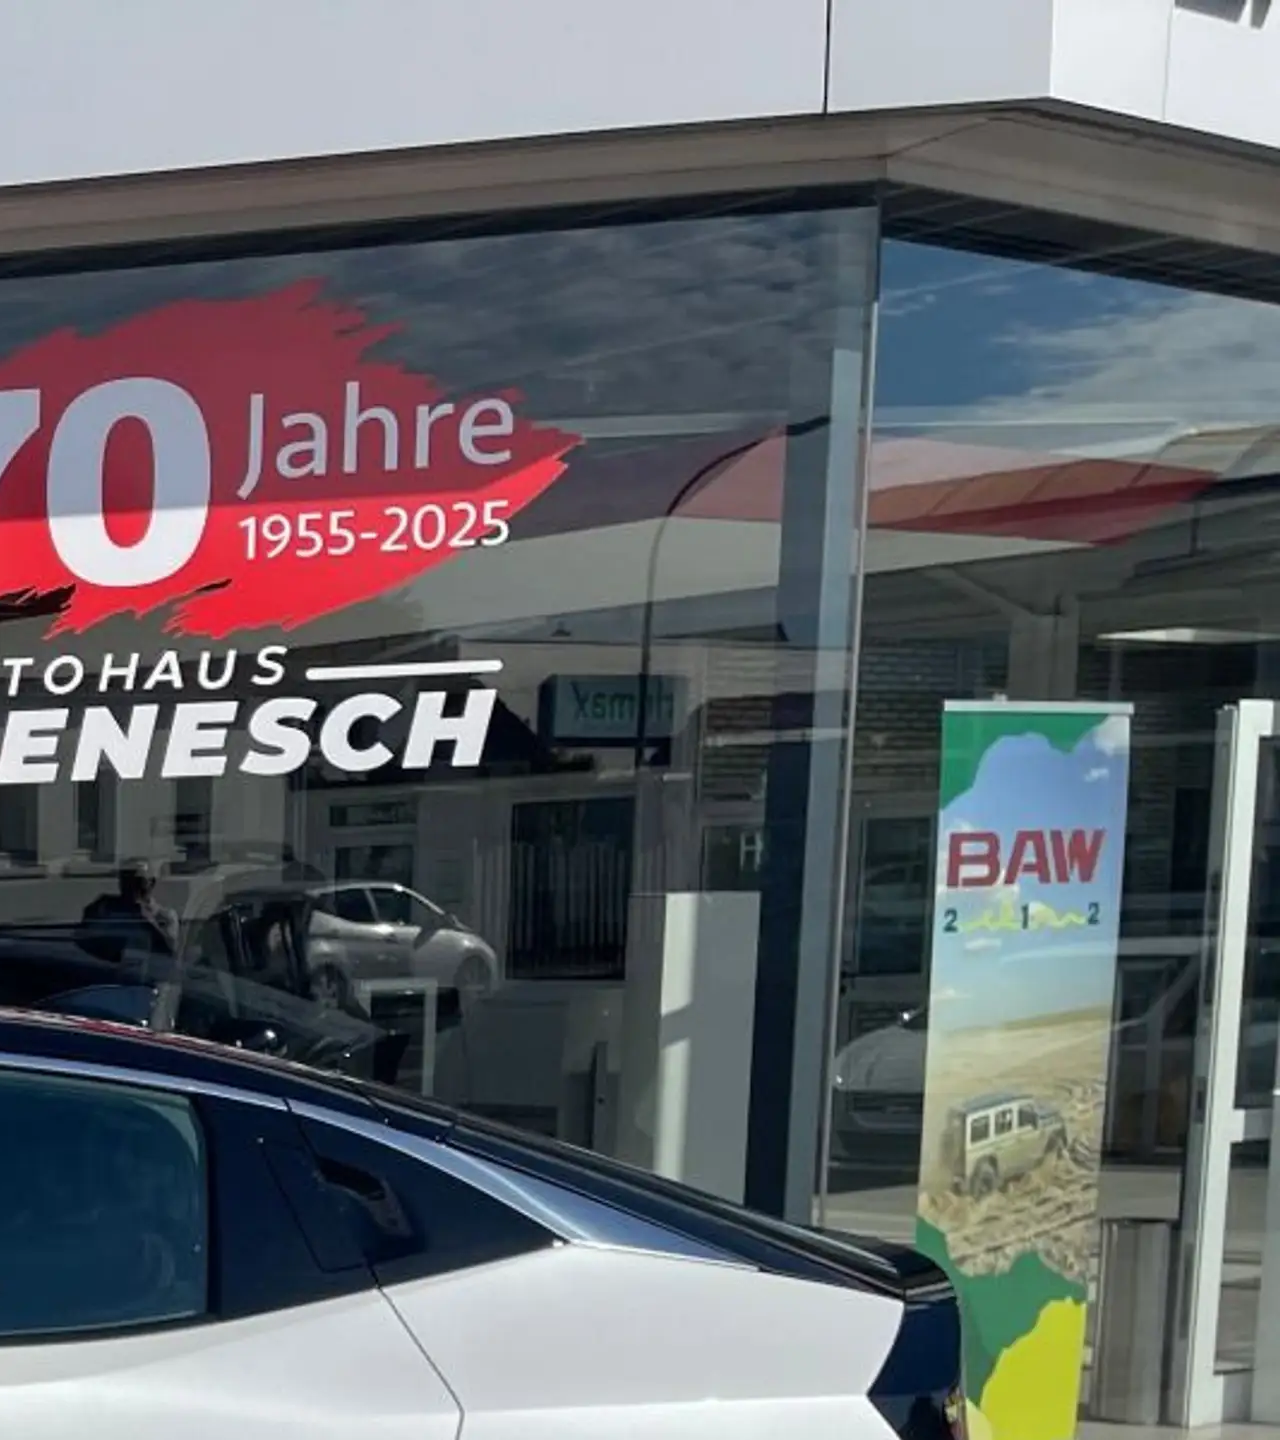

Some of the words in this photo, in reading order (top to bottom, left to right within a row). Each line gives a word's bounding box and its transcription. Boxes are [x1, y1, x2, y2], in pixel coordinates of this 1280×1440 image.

[236, 380, 514, 500] Jahre
[237, 499, 511, 560] 1955-2025
[946, 828, 1107, 888] BAW
[943, 908, 958, 933] 2
[1087, 901, 1100, 925] 2
